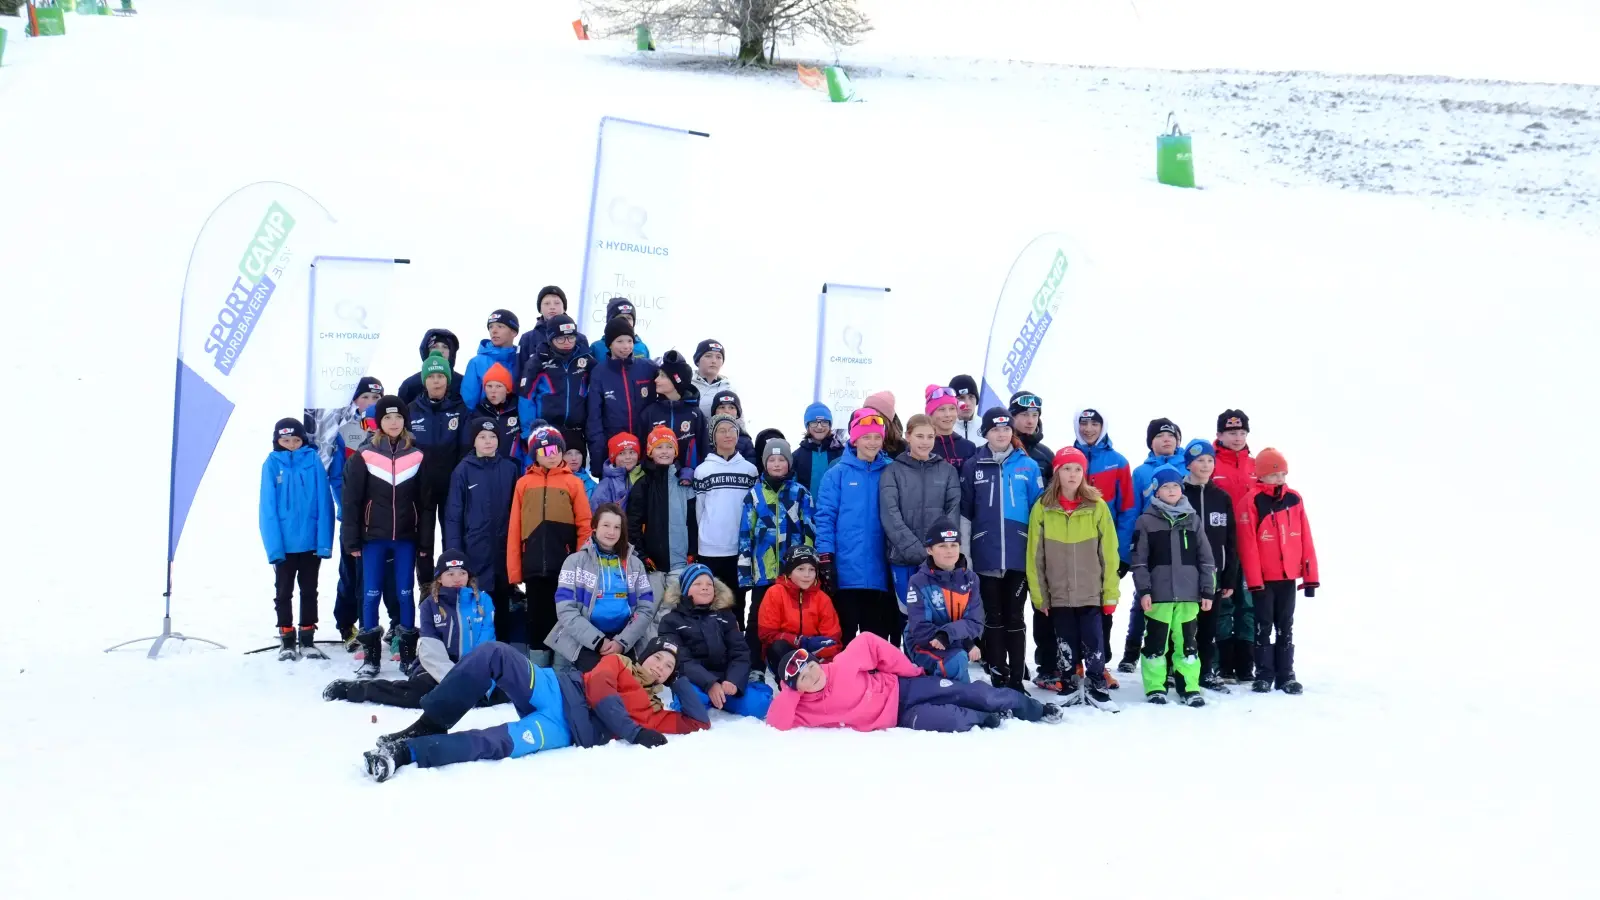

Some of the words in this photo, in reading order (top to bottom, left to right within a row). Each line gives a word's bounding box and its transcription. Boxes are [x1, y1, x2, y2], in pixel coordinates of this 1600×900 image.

[204, 275, 251, 353] SPORT
[245, 210, 285, 277] CAMP
[606, 240, 669, 256] HYDRAULICS
[221, 282, 270, 369] NORDBAYERN
[1002, 310, 1037, 375] SPORT
